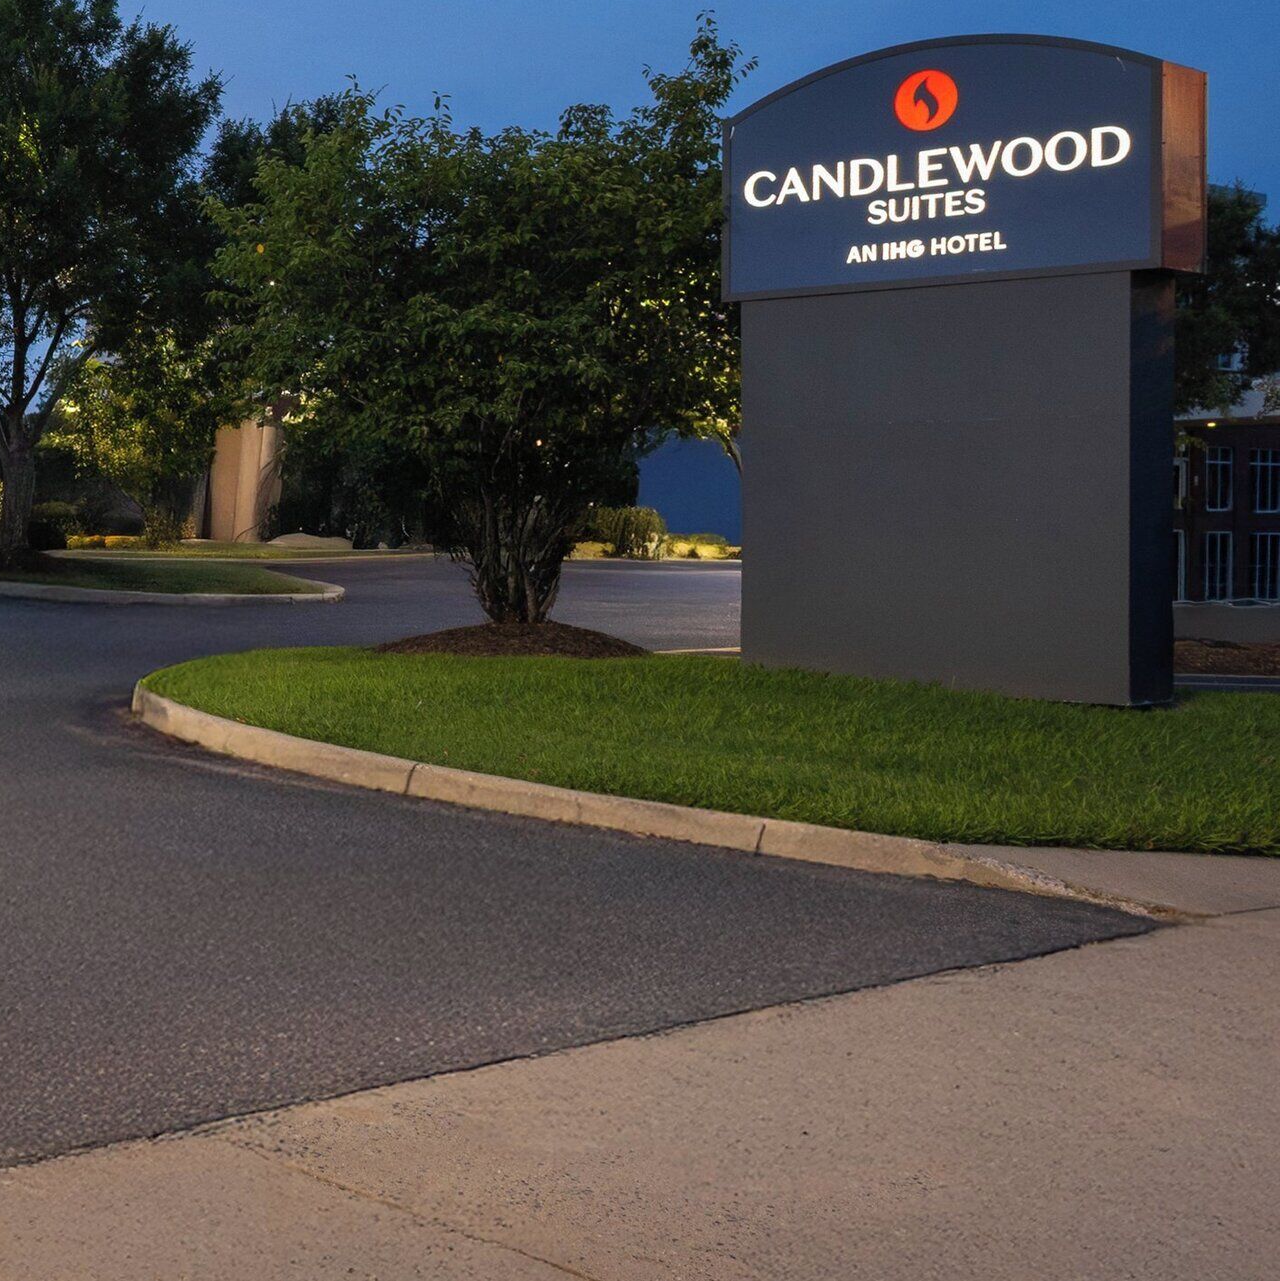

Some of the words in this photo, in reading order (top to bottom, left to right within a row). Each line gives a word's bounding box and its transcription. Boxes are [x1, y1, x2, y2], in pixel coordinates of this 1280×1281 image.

[743, 125, 1131, 208] CANDLEWOOD
[867, 189, 986, 225] SUITES
[846, 244, 878, 264] AN
[882, 239, 925, 261] IHG
[931, 231, 1007, 256] HOTEL
